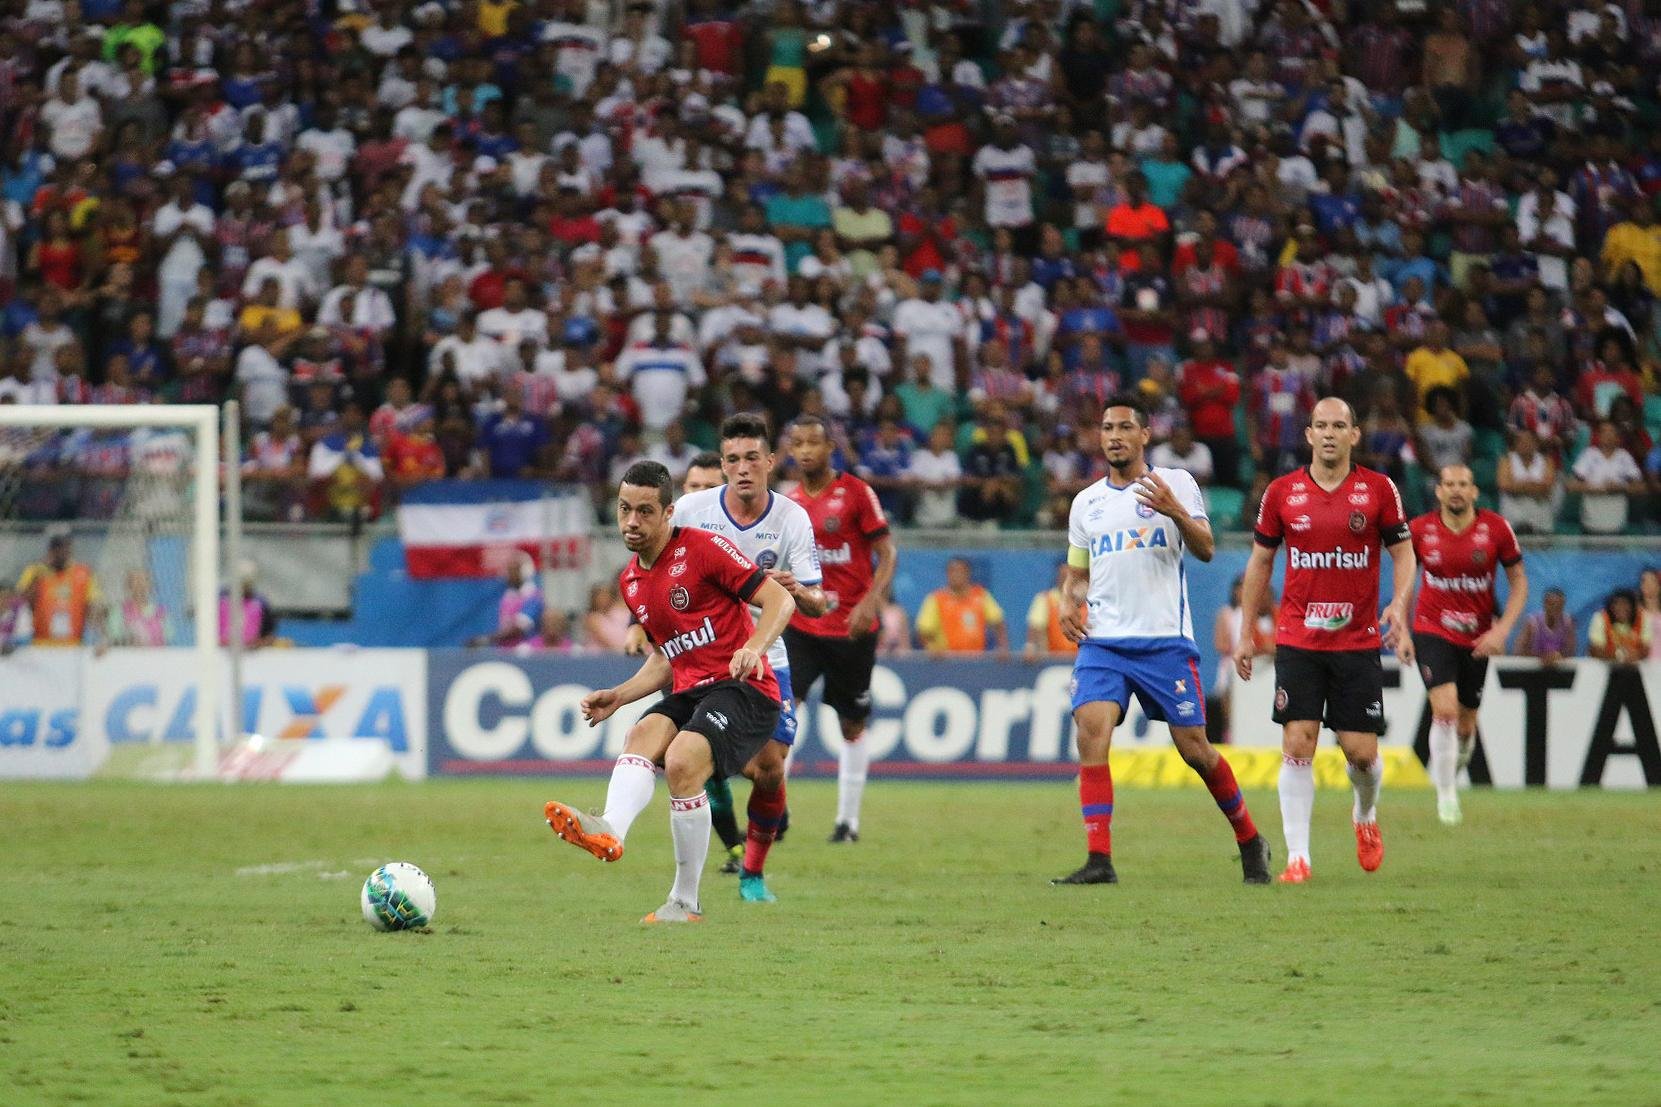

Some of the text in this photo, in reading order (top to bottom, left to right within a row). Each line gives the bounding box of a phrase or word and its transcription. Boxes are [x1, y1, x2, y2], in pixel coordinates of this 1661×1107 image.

[700, 522, 726, 531] MRV
[755, 532, 780, 540] MRV
[1090, 527, 1168, 558] CAIXA
[1290, 545, 1369, 569] Banrisul
[105, 683, 410, 754] CAIXA
[706, 711, 725, 730] Topper
